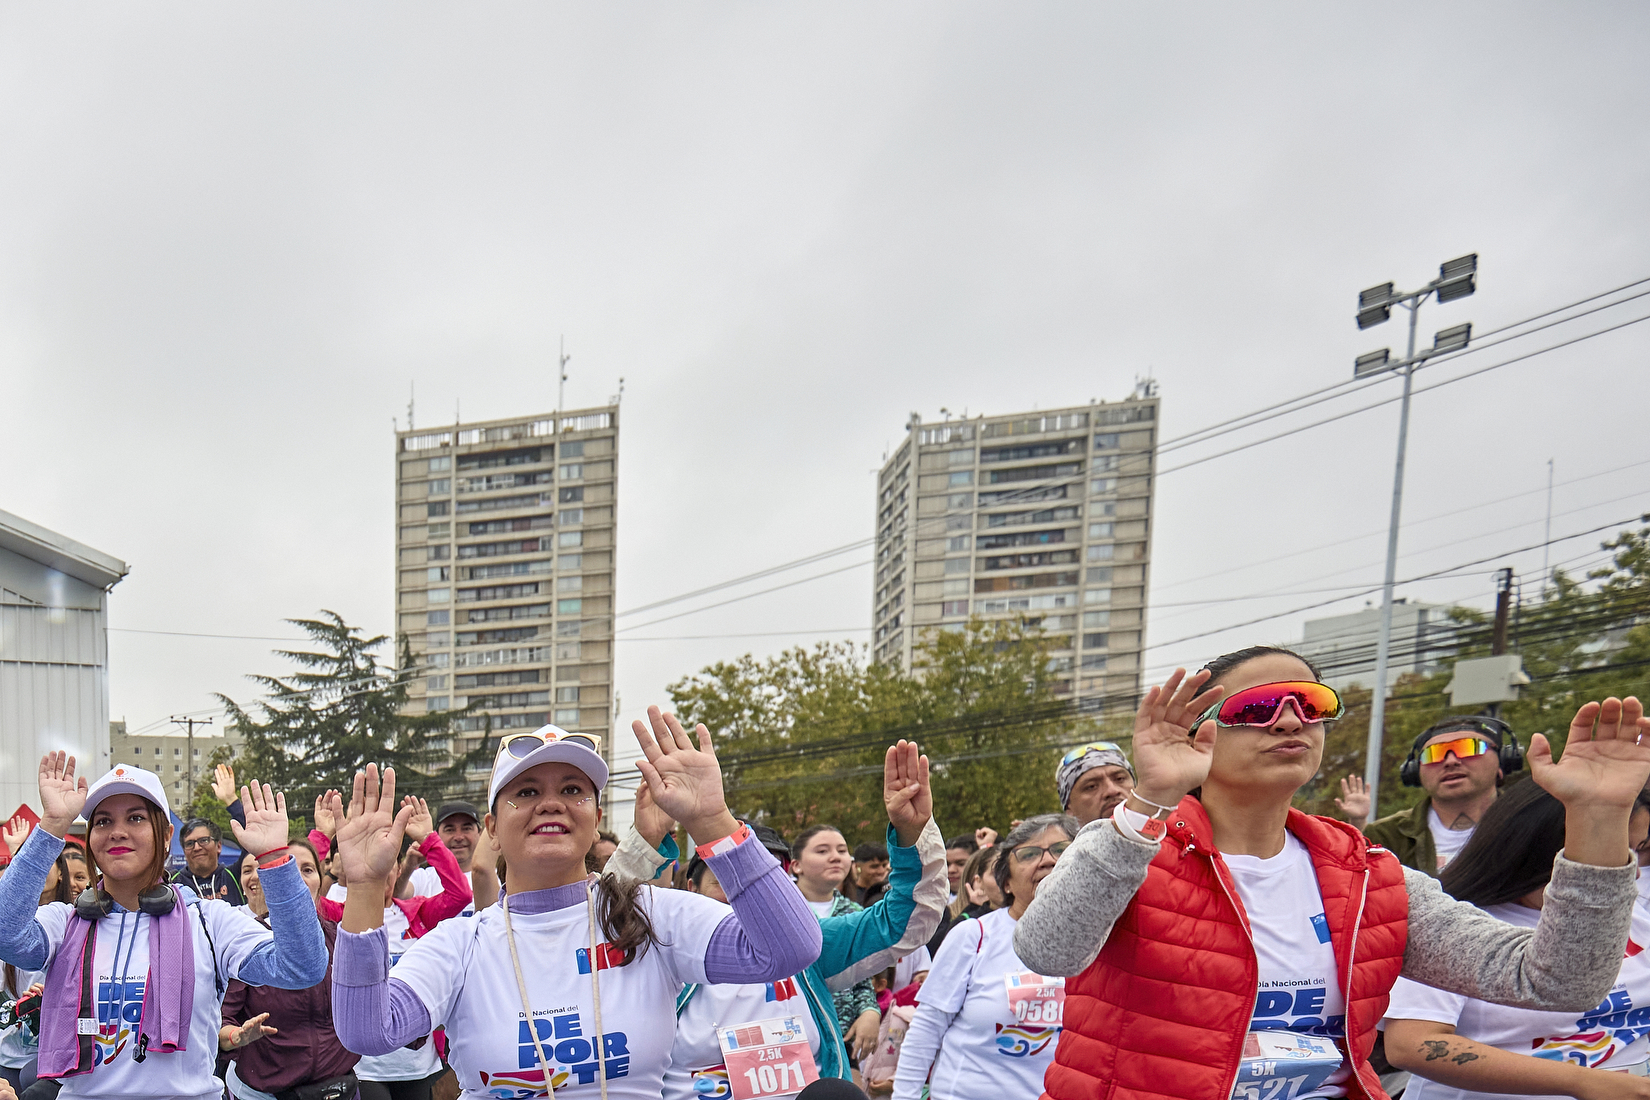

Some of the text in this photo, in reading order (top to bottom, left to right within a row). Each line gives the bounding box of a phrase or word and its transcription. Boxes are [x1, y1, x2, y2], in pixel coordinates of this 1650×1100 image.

[98, 981, 146, 1002] DE
[1271, 978, 1312, 988] Nacional
[1312, 977, 1326, 985] del
[98, 1002, 144, 1024] PO
[532, 1006, 566, 1017] Nacional
[566, 1004, 579, 1012] del
[1014, 999, 1065, 1022] 058
[1253, 987, 1327, 1019] DE
[518, 1013, 583, 1044] DE
[518, 1031, 631, 1069] POR
[757, 1047, 783, 1062] 2,5K
[571, 1056, 630, 1086] TE
[744, 1060, 806, 1095] 1071
[1251, 1061, 1277, 1077] 5K
